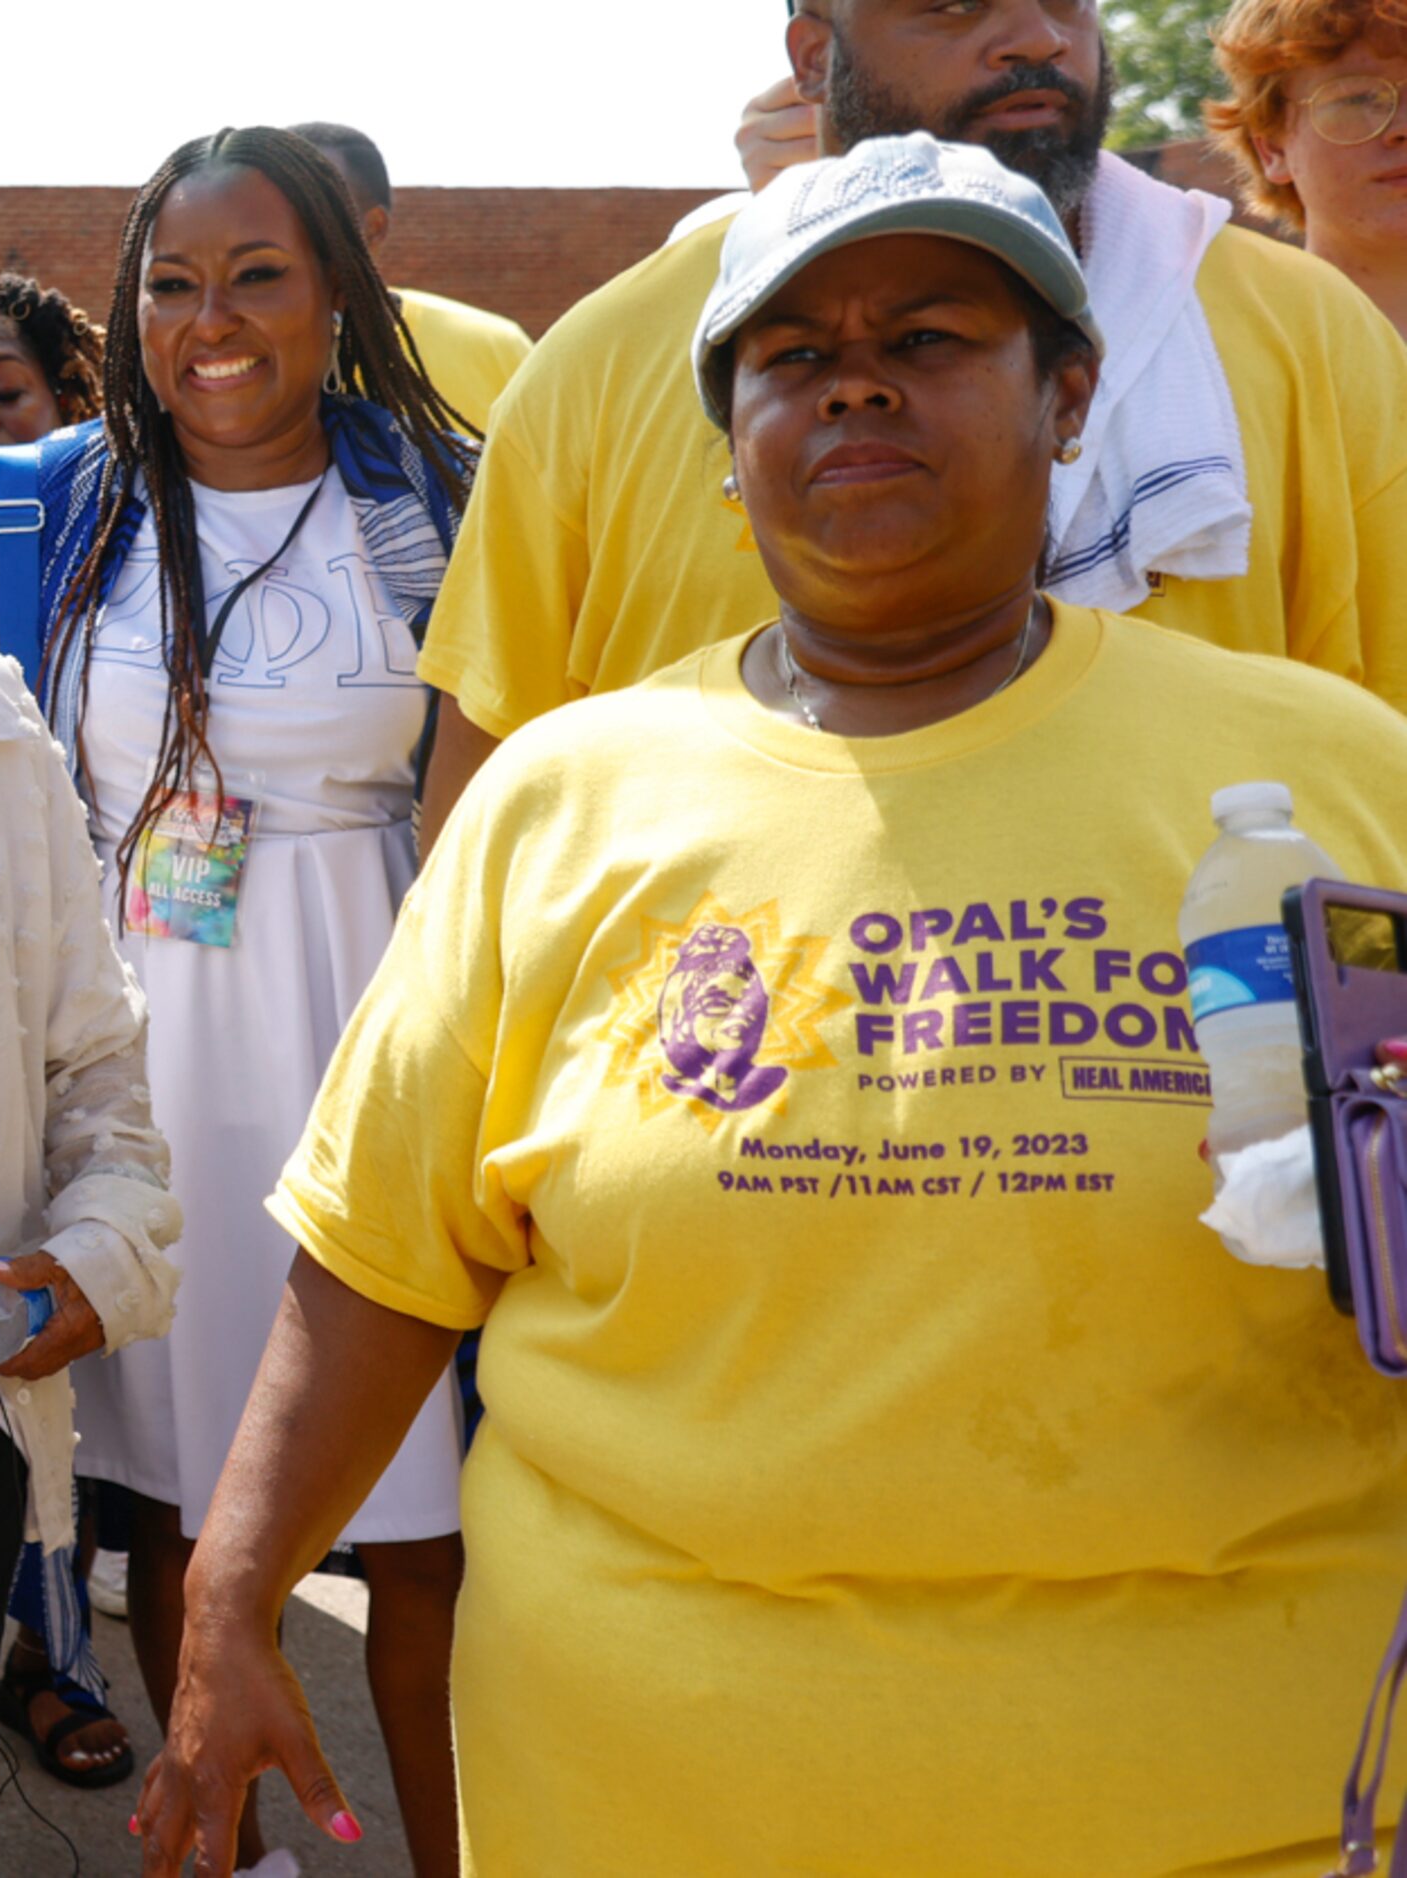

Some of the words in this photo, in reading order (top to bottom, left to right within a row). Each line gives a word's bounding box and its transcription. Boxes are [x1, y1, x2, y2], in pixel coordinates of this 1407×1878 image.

[171, 854, 211, 884] VIP
[148, 882, 169, 899] ALL
[173, 886, 222, 908] ACCESS
[849, 896, 1108, 955] OPAL'S
[848, 948, 1068, 1006] WALK
[1093, 949, 1189, 997] FO
[858, 1064, 997, 1093] POWERED
[1010, 1064, 1047, 1083] BY
[1072, 1067, 1124, 1091] HEAL
[740, 1137, 867, 1166] Monday,
[878, 1138, 946, 1161] June
[958, 1135, 1001, 1161] 19,
[1012, 1133, 1089, 1156] 2023
[717, 1170, 774, 1194] 9AM
[779, 1177, 819, 1195] PST
[921, 1176, 961, 1195] CST
[997, 1171, 1067, 1193] 12PM
[1076, 1173, 1114, 1192] EST
